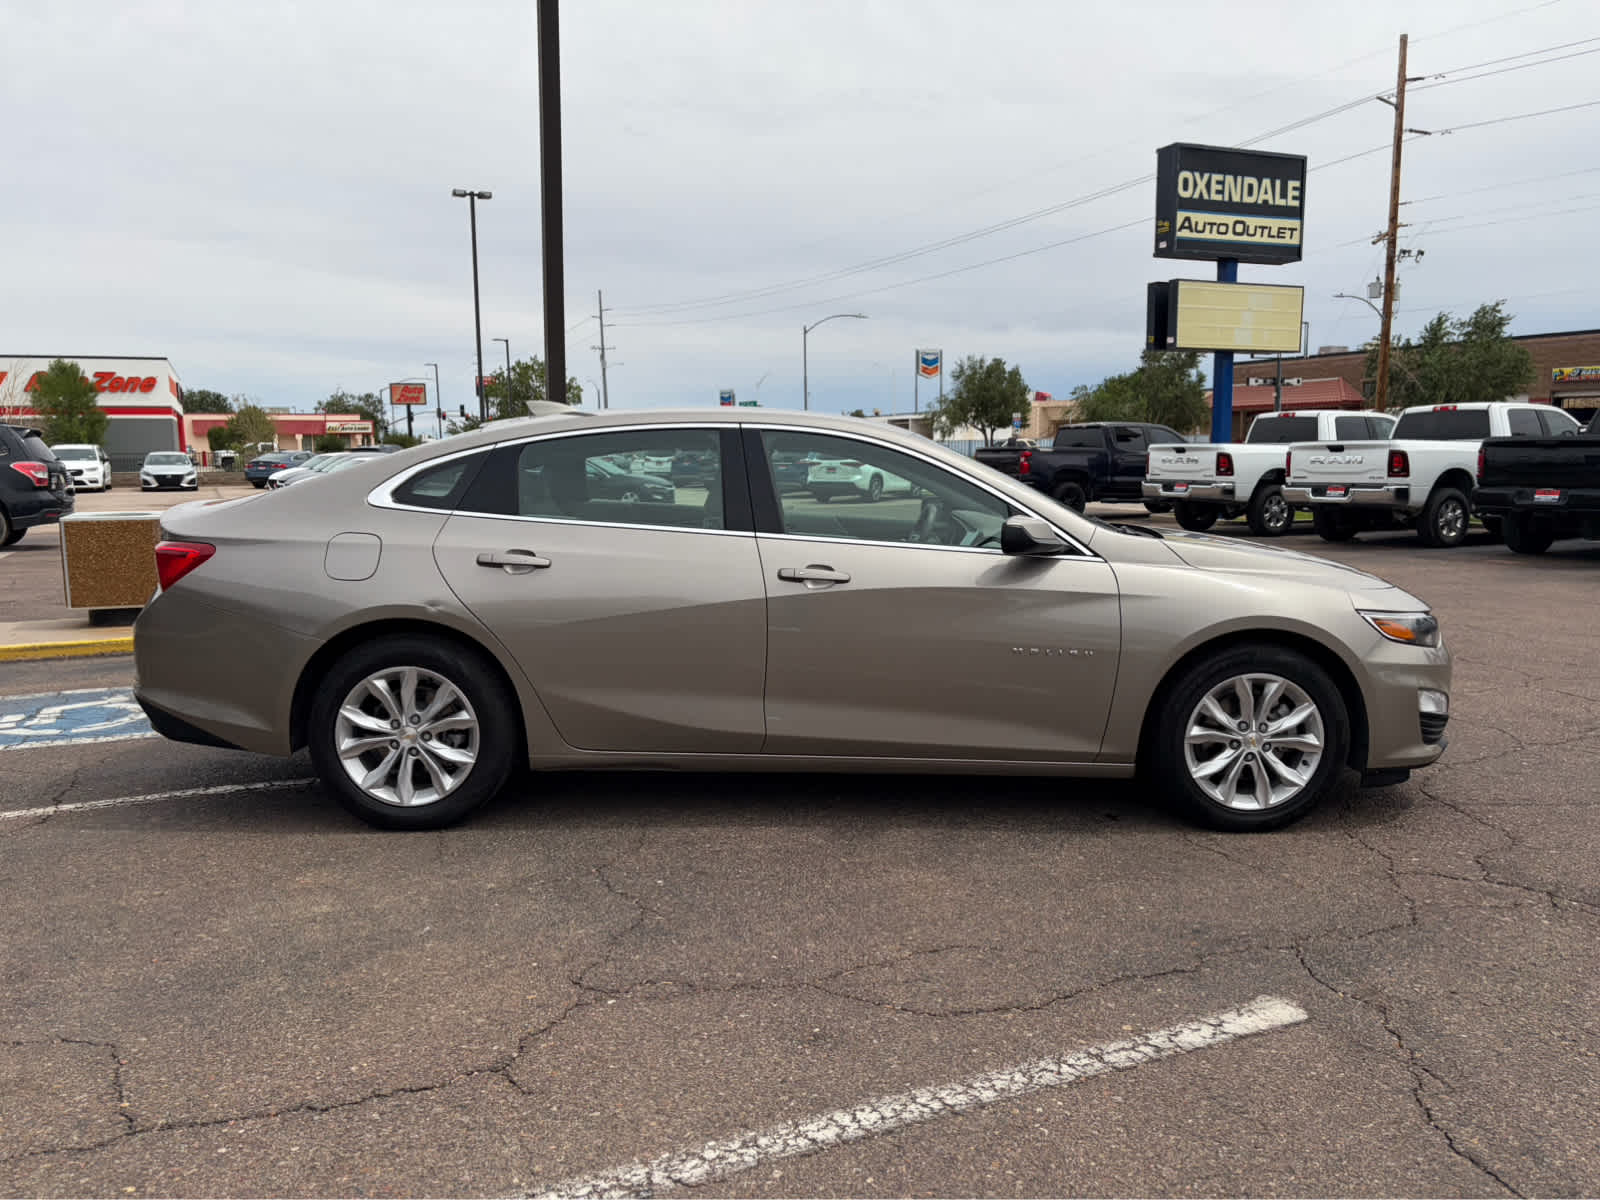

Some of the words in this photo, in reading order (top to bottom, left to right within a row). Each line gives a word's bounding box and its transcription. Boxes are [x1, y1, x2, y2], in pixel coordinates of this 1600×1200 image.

[1177, 170, 1300, 207] OXENDALE
[1178, 216, 1229, 235] AUTO
[1232, 220, 1298, 240] OUTLET
[1310, 455, 1364, 465] RAM
